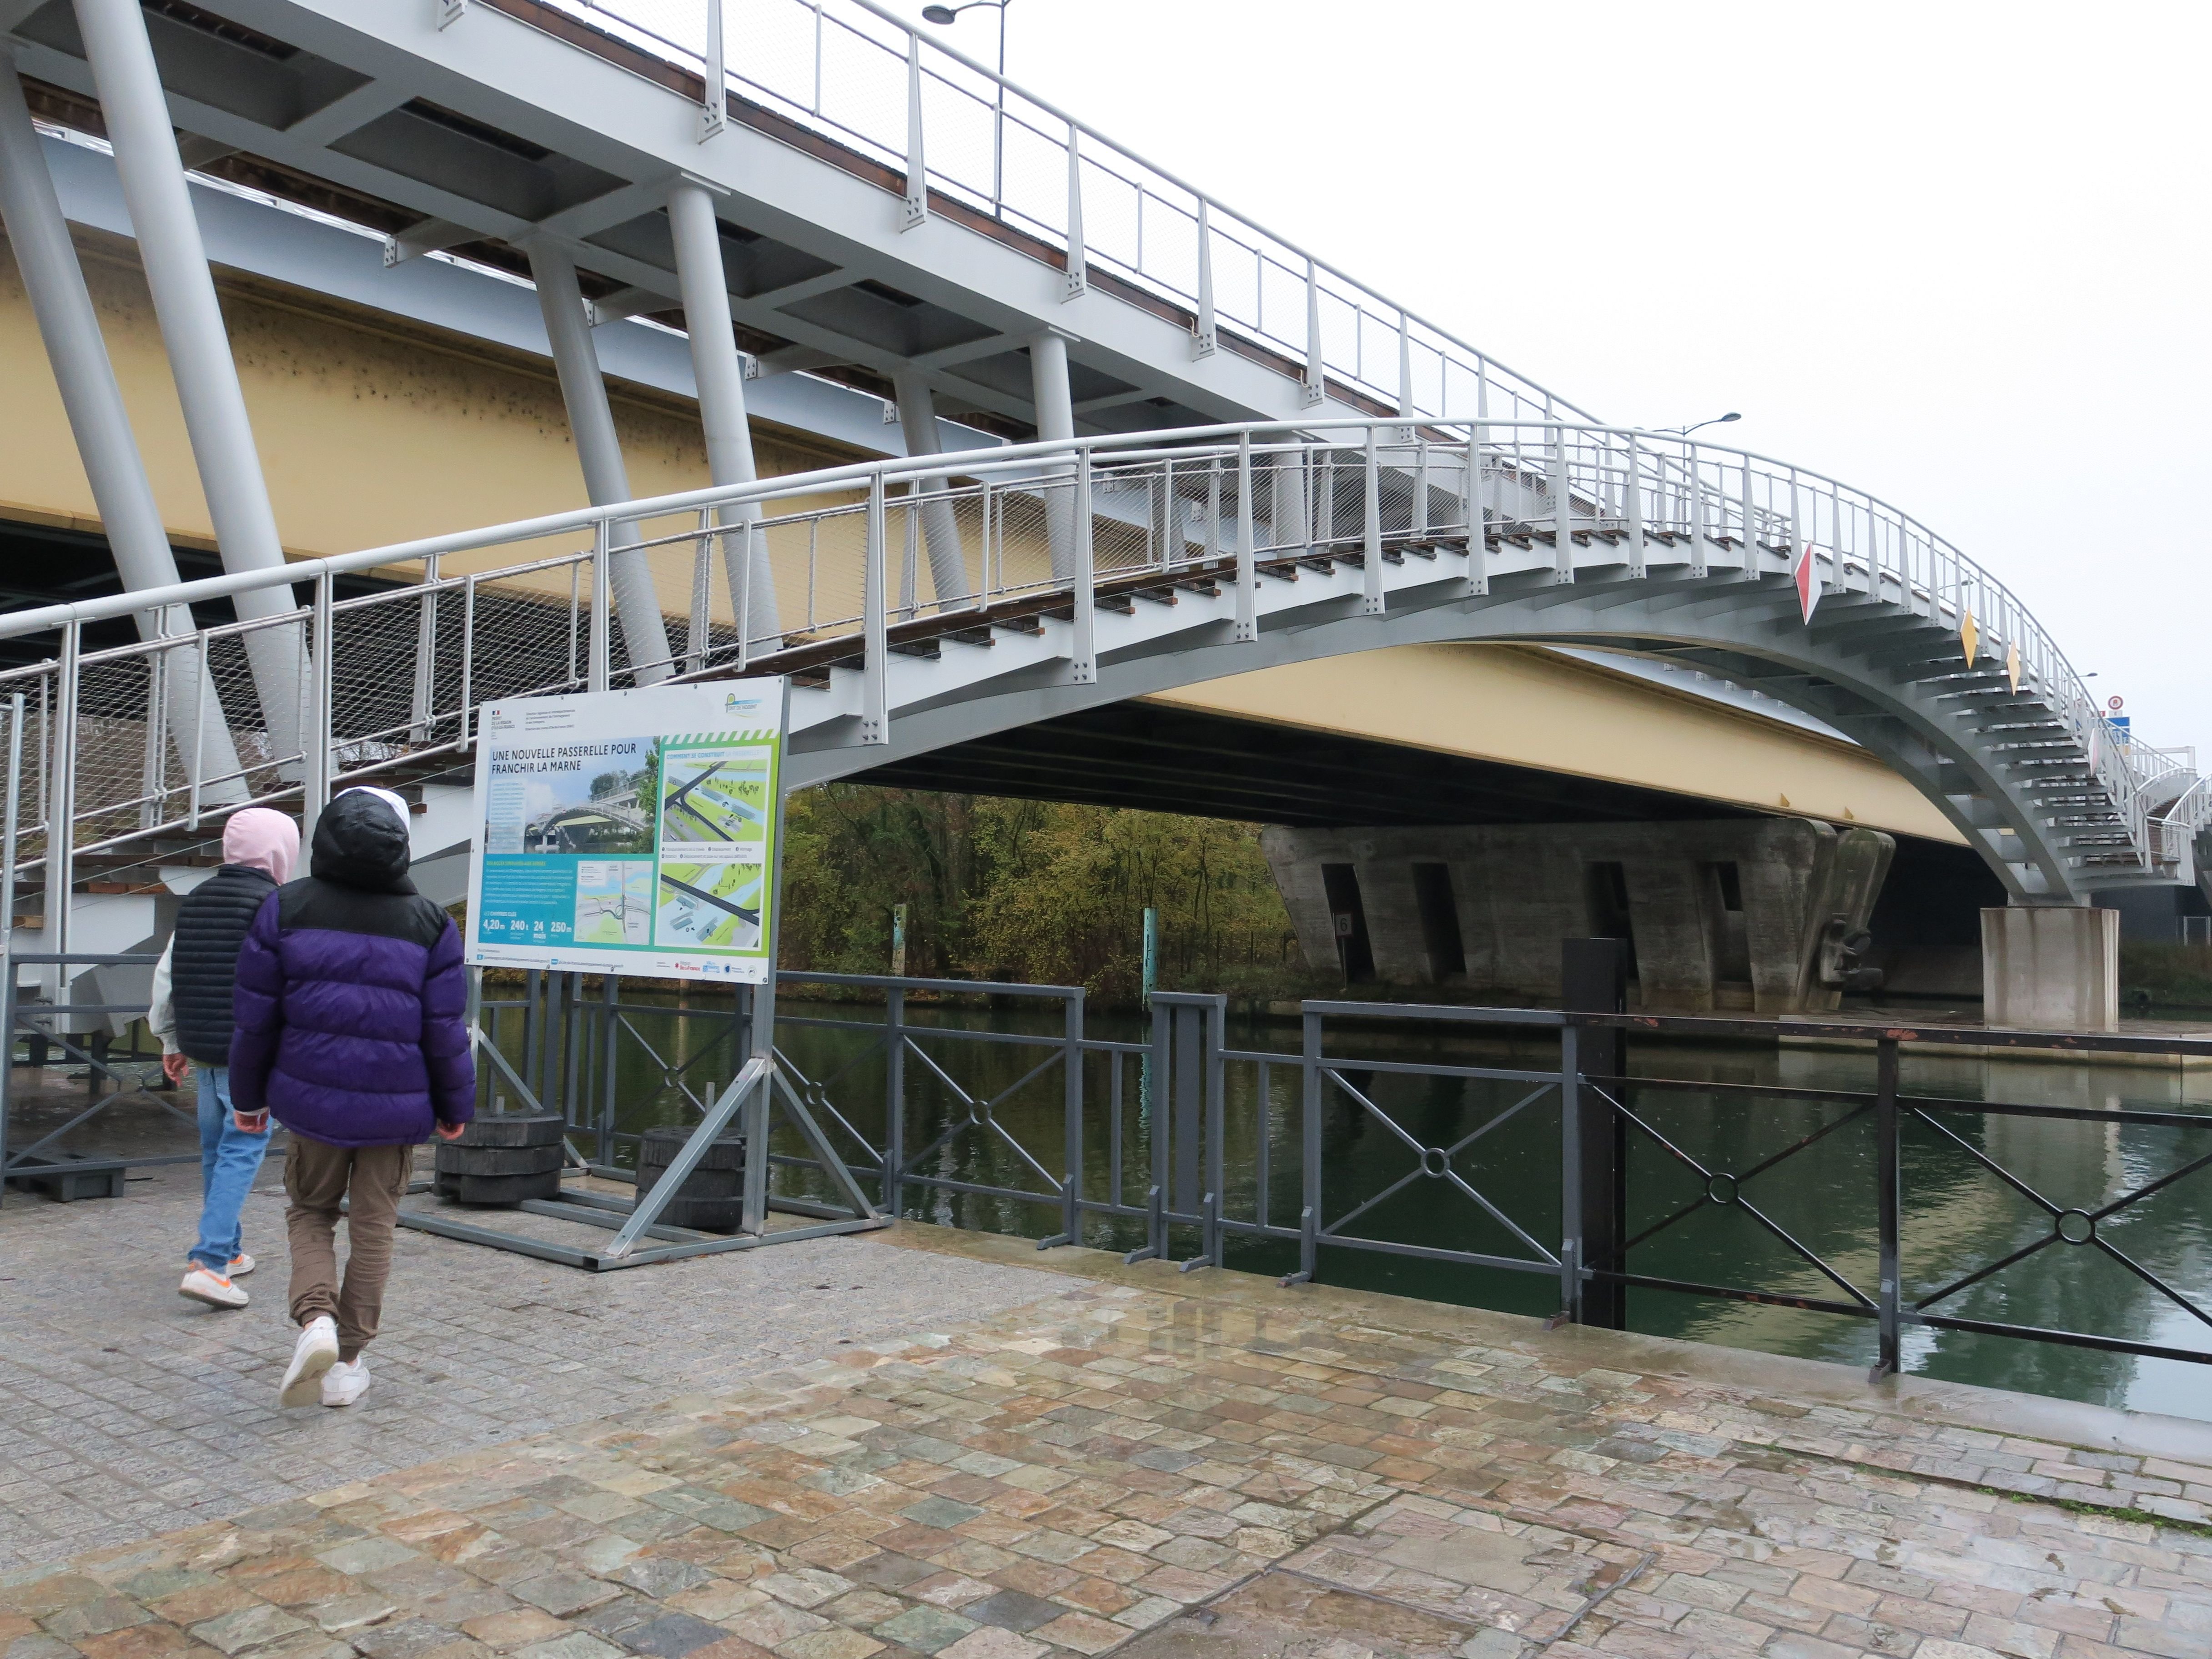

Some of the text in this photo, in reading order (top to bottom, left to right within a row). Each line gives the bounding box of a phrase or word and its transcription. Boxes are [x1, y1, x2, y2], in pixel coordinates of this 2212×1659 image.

[493, 744, 636, 761] UNE NOUVELLE PASSERELLE POUR
[492, 760, 581, 774] FRANCHIR LA MARNE
[483, 919, 499, 931] 4,20
[510, 920, 525, 930] 240
[534, 921, 543, 931] 24
[551, 921, 566, 932] 250
[1340, 918, 1347, 931] 6
